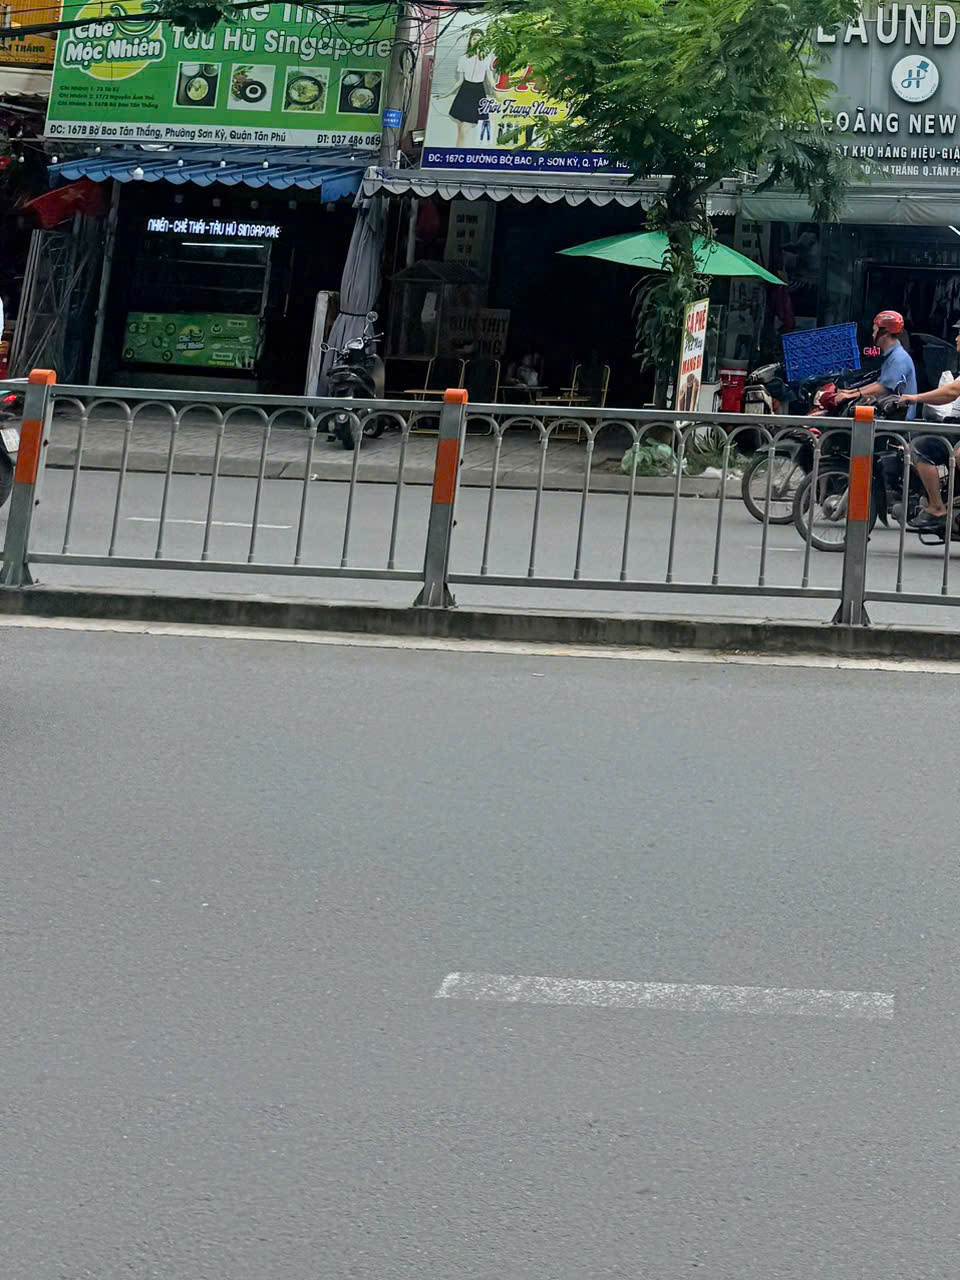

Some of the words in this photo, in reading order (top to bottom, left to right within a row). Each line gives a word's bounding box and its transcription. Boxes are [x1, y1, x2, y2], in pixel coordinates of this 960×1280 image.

[66, 42, 103, 65] Mộc
[107, 38, 160, 58] Nhiên
[224, 28, 256, 52] Hũ
[264, 30, 392, 61] Singapore
[503, 100, 531, 116] Trang
[532, 101, 557, 115] Nam
[909, 113, 957, 134] NEW
[50, 124, 65, 134] ĐC:
[68, 125, 86, 135] 167B
[89, 123, 100, 135] Bờ
[102, 126, 116, 136] Bao
[120, 126, 133, 136] Tân
[136, 124, 163, 139] Thắng,
[165, 127, 195, 140] Phường
[198, 129, 213, 138] Sơn
[215, 129, 227, 140] Kỳ,
[230, 130, 251, 142] Quận
[255, 130, 268, 141] Tân
[271, 132, 286, 142] Phú
[317, 135, 329, 144] ĐT:
[331, 135, 345, 144] 037
[878, 143, 906, 158] HÀNG
[429, 154, 443, 162] ĐC:
[445, 154, 464, 163] 167C
[466, 154, 497, 163] ĐƯỜNG
[539, 157, 545, 166] P.
[547, 157, 565, 166] SƠN
[567, 156, 580, 168] KỲ,
[582, 159, 590, 167] Q.
[611, 160, 630, 169] HÚ,
[892, 161, 919, 176] THẮNG
[238, 223, 280, 238] SINGAPORE
